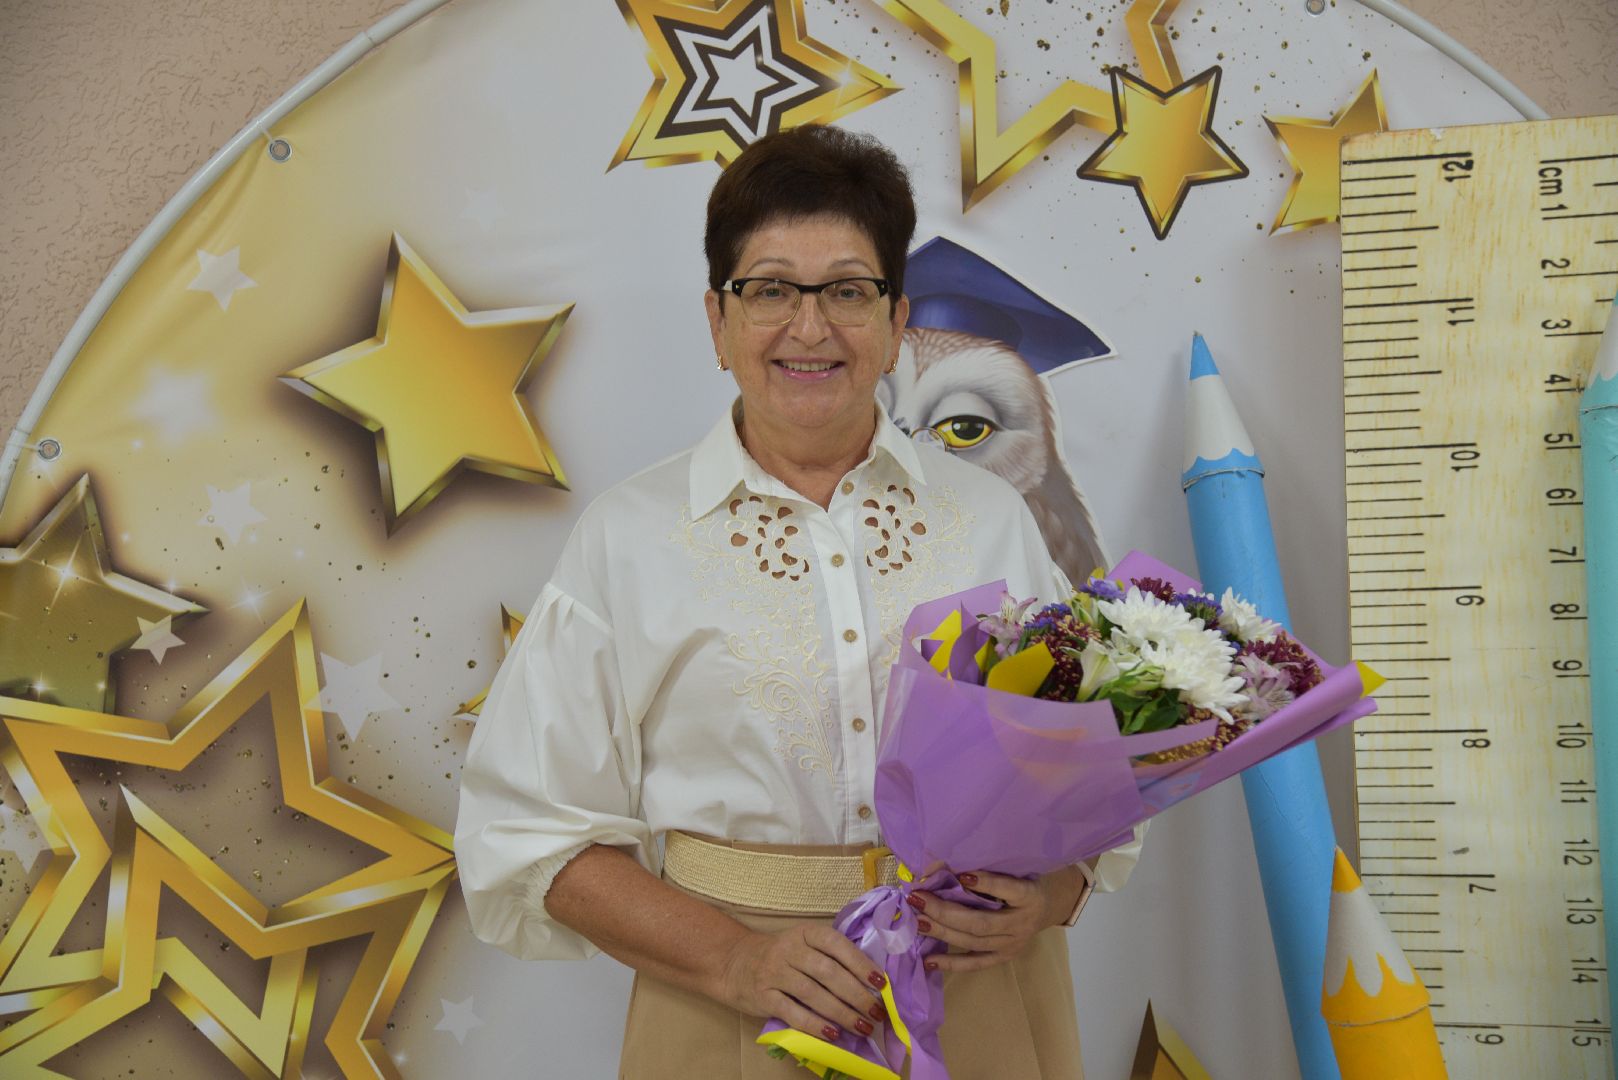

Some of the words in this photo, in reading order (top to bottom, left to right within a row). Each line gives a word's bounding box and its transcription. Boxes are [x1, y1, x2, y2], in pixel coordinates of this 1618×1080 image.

[1442, 159, 1474, 183] 12
[1538, 166, 1563, 196] cm
[1540, 203, 1568, 212] 1
[1541, 258, 1571, 270] 2
[1447, 305, 1475, 326] 11
[1541, 319, 1572, 330] 3
[1544, 374, 1571, 385] 4
[1544, 432, 1574, 444] 5
[1451, 449, 1480, 472] 10
[1545, 487, 1577, 499] 6
[1548, 546, 1577, 557] 7
[1455, 594, 1485, 606] 9
[1550, 603, 1580, 614] 8
[1552, 659, 1583, 671] 9
[1556, 722, 1587, 749] 10
[1461, 738, 1491, 749] 8
[1563, 838, 1593, 866] 12
[1468, 883, 1497, 894] 7
[1566, 897, 1597, 925] 13
[1571, 956, 1599, 984] 14
